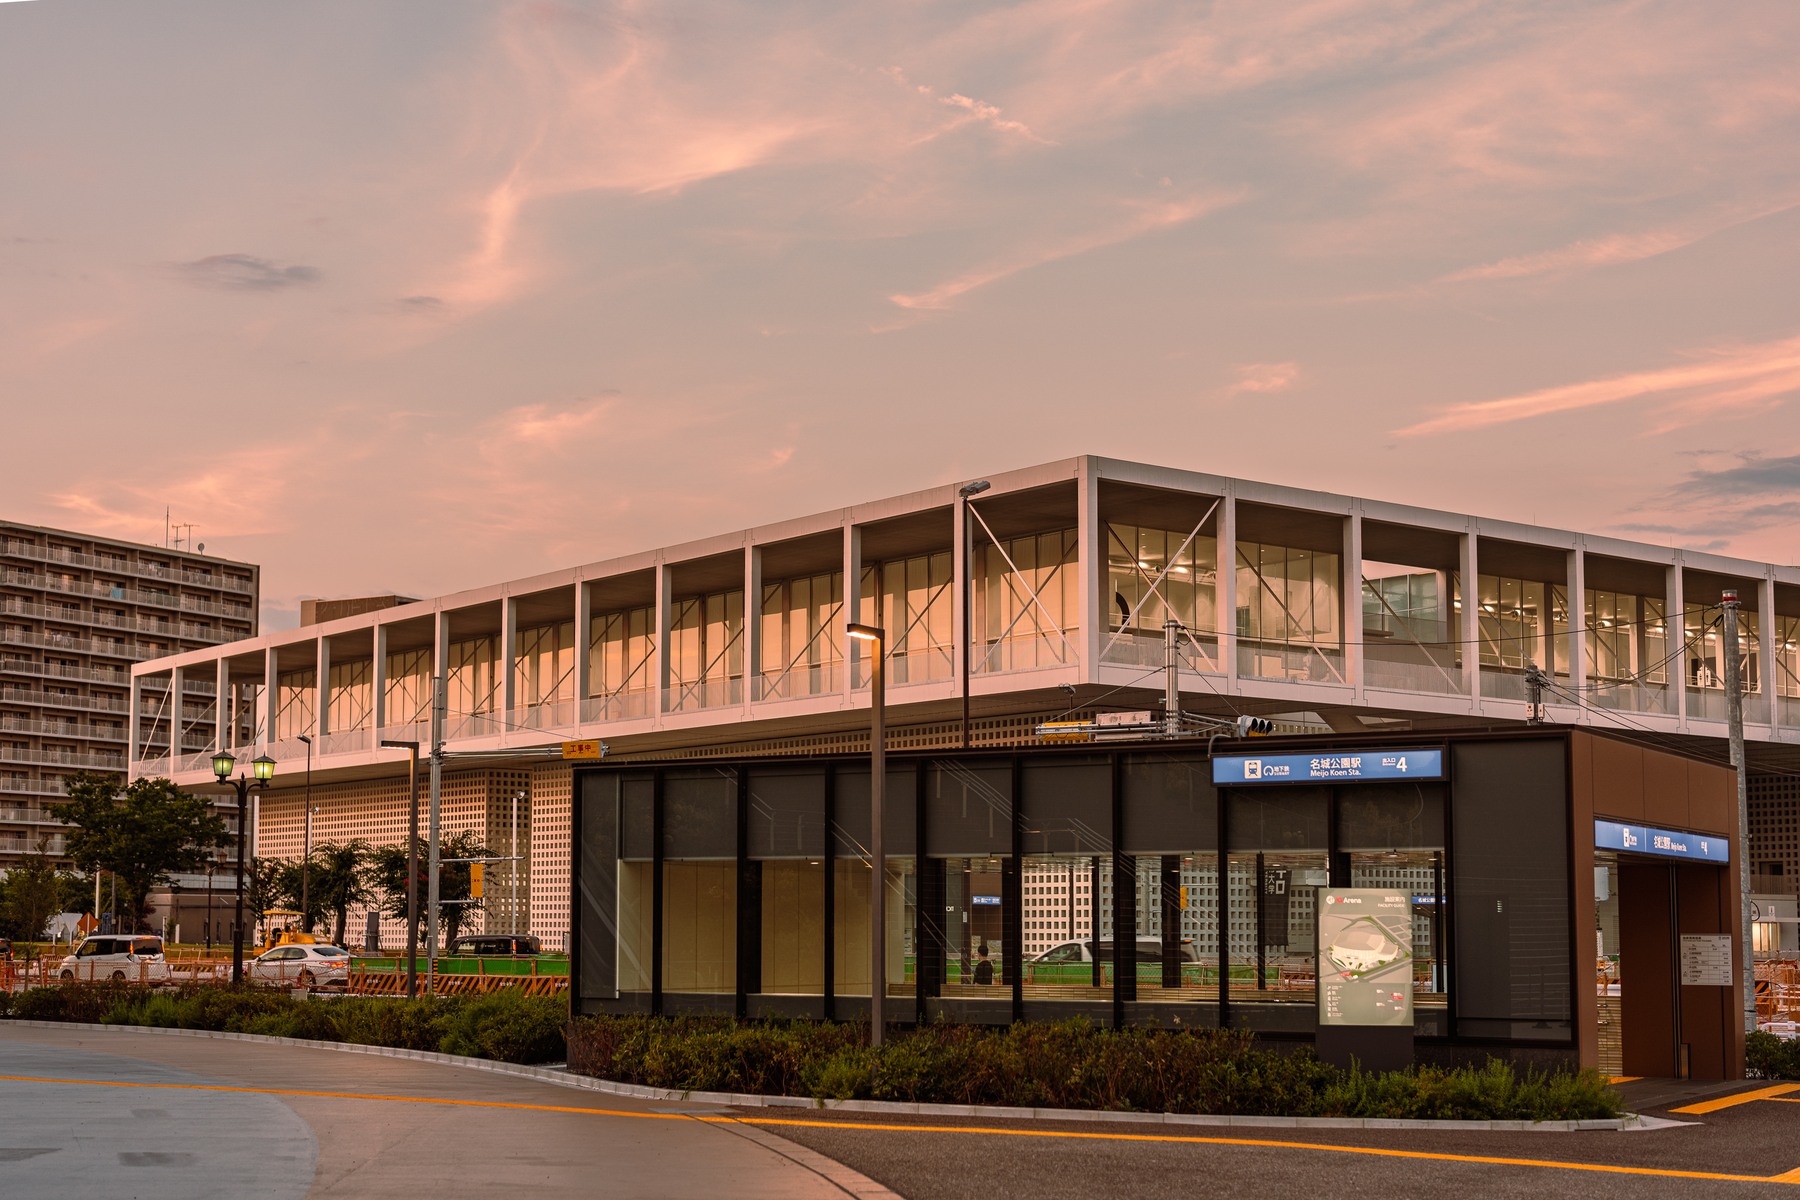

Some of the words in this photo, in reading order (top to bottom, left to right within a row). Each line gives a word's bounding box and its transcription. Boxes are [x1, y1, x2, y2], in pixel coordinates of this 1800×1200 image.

[570, 744, 591, 753] 工事中
[1310, 757, 1361, 769] 名城公園駅
[1396, 756, 1408, 772] 4
[1310, 769, 1329, 778] Meijo
[1348, 768, 1361, 776] Sta.
[1343, 896, 1362, 904] Arena
